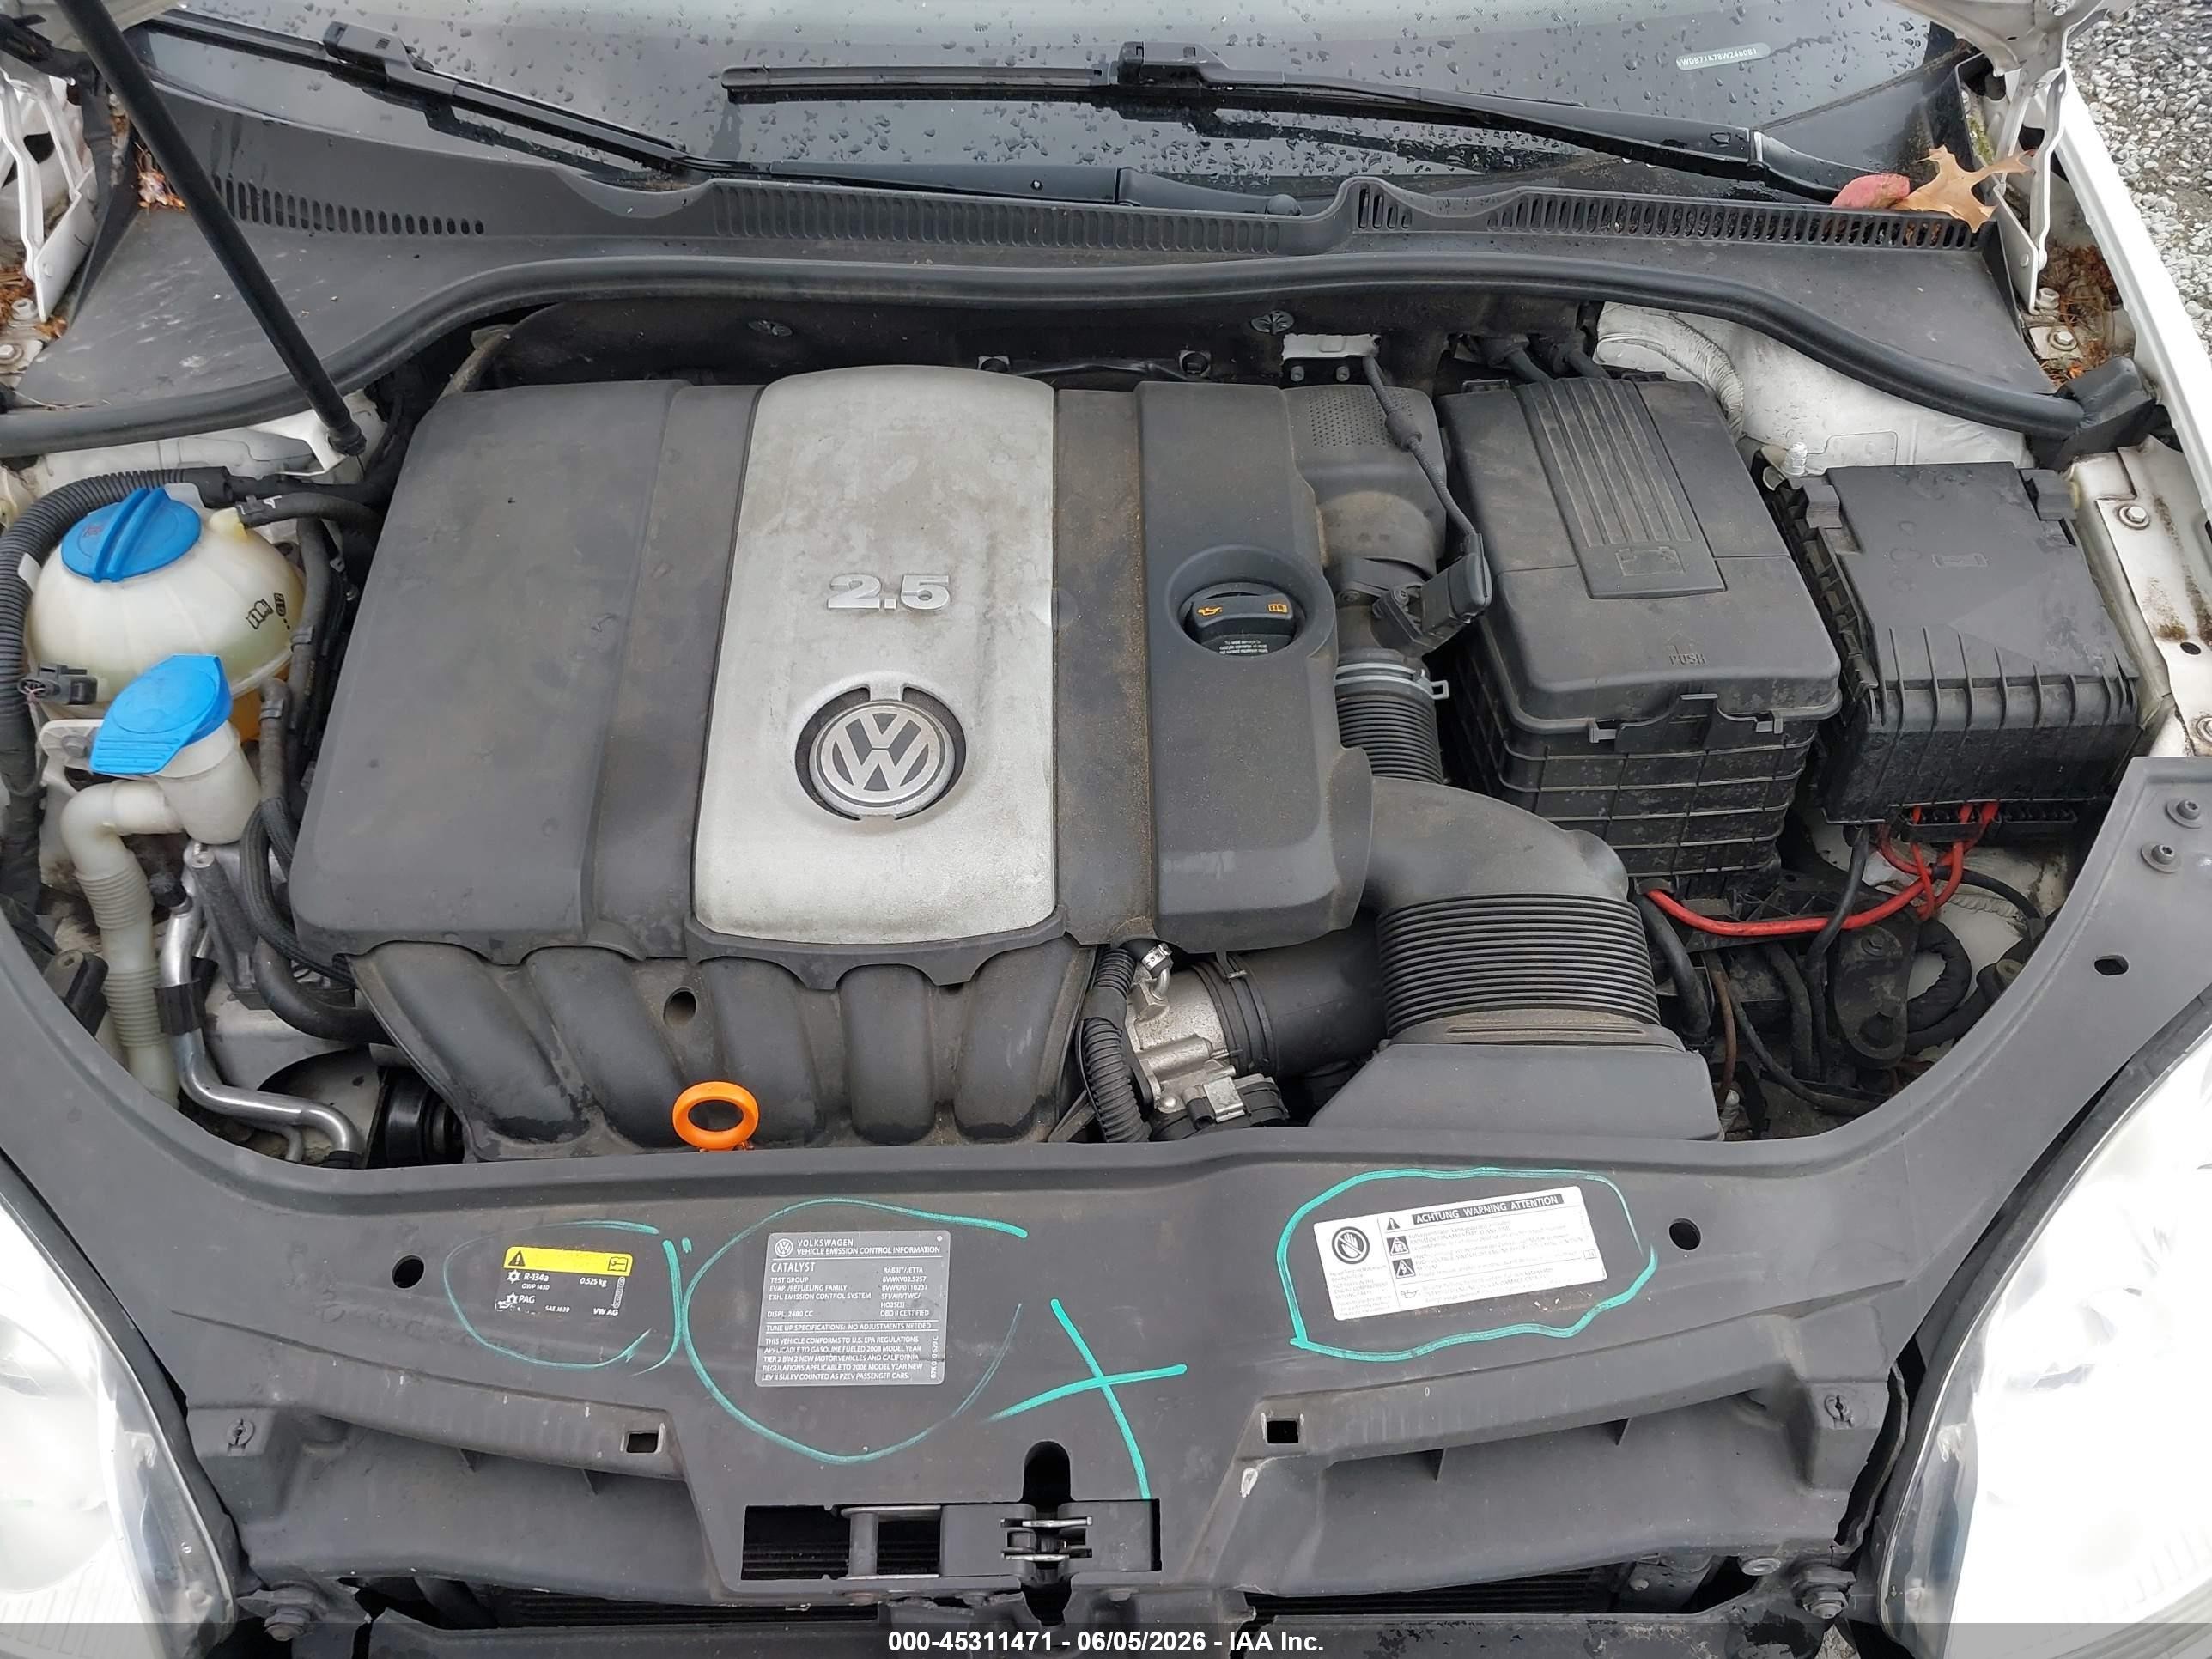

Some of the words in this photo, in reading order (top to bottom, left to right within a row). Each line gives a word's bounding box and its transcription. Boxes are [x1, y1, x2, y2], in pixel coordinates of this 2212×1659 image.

[826, 573, 951, 611] 2.5
[1668, 653, 1705, 665] PUSH
[1416, 1209, 1460, 1224] ACHTUNG
[1464, 1202, 1507, 1218] WARNING
[1510, 1195, 1558, 1210] ATTENTION
[771, 1262, 816, 1273] CATALYST
[523, 1273, 549, 1282] R-134a
[580, 1277, 598, 1285] 0.525
[599, 1279, 607, 1287] kg
[519, 1295, 536, 1304] PAG
